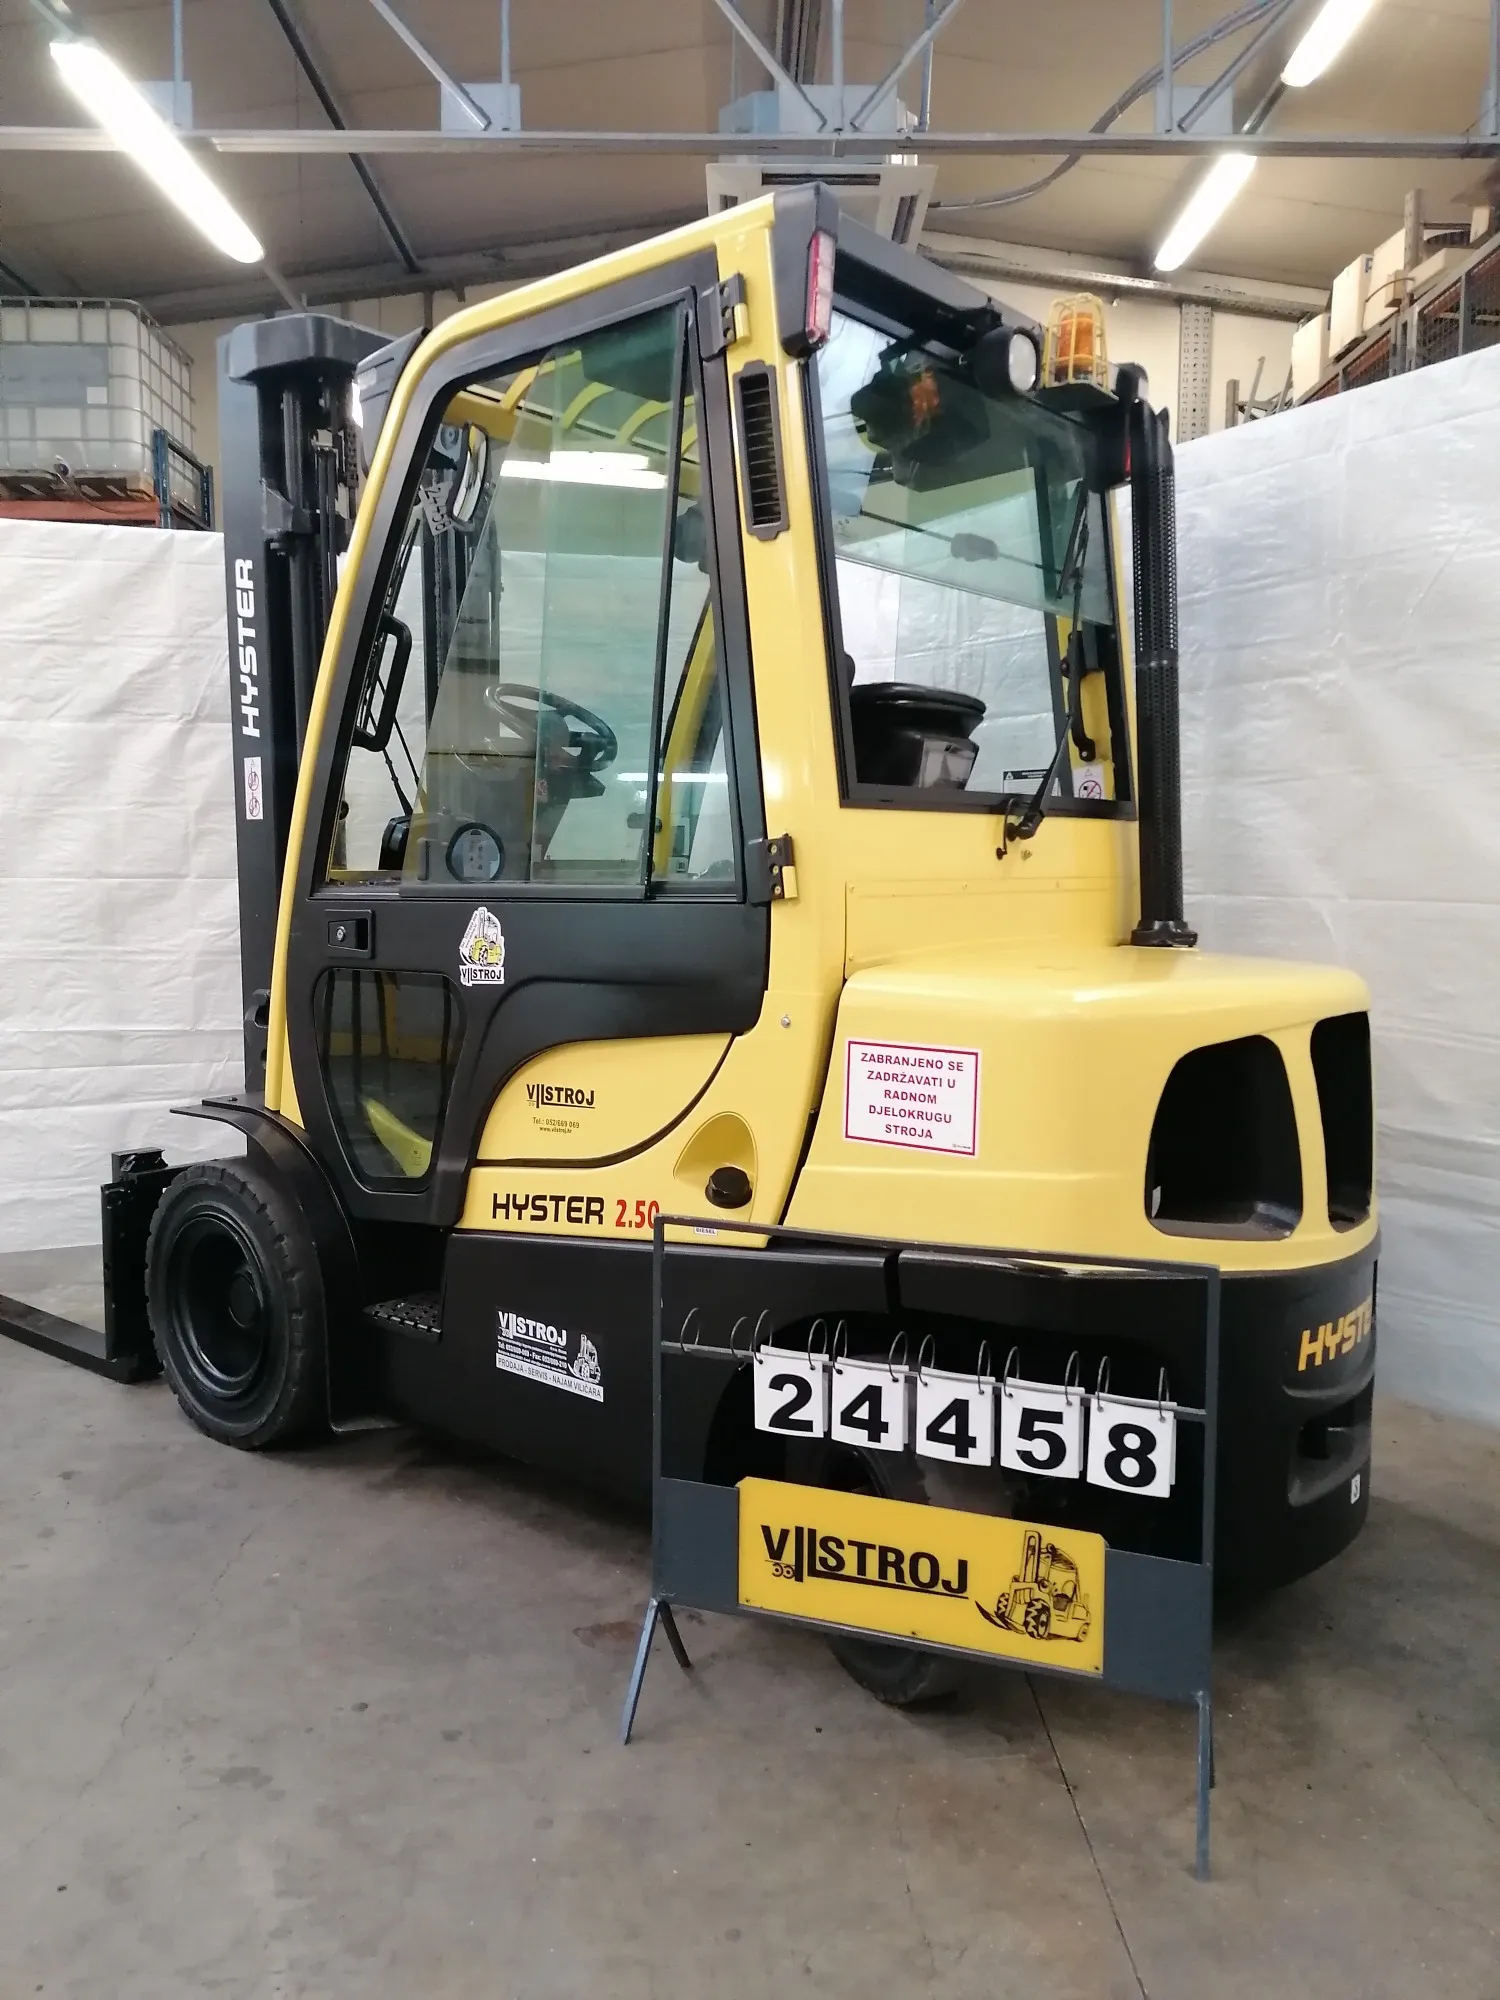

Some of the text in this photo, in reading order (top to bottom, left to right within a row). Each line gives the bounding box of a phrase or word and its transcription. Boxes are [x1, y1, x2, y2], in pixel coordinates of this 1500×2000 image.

[234, 558, 260, 738] HYSTER
[860, 1052, 964, 1072] ZABRANJENO SE
[867, 1070, 956, 1089] ZADRŽAVATI U
[884, 1089, 937, 1104] RADNOM
[868, 1105, 952, 1124] DJELOKRUGU
[885, 1124, 933, 1139] STROJA
[492, 1192, 605, 1225] HYSTER
[1298, 1295, 1372, 1372] HYSTE
[498, 1357, 524, 1373] PRODAJA
[528, 1367, 548, 1381] SERVIS
[552, 1375, 573, 1389] NAJAM
